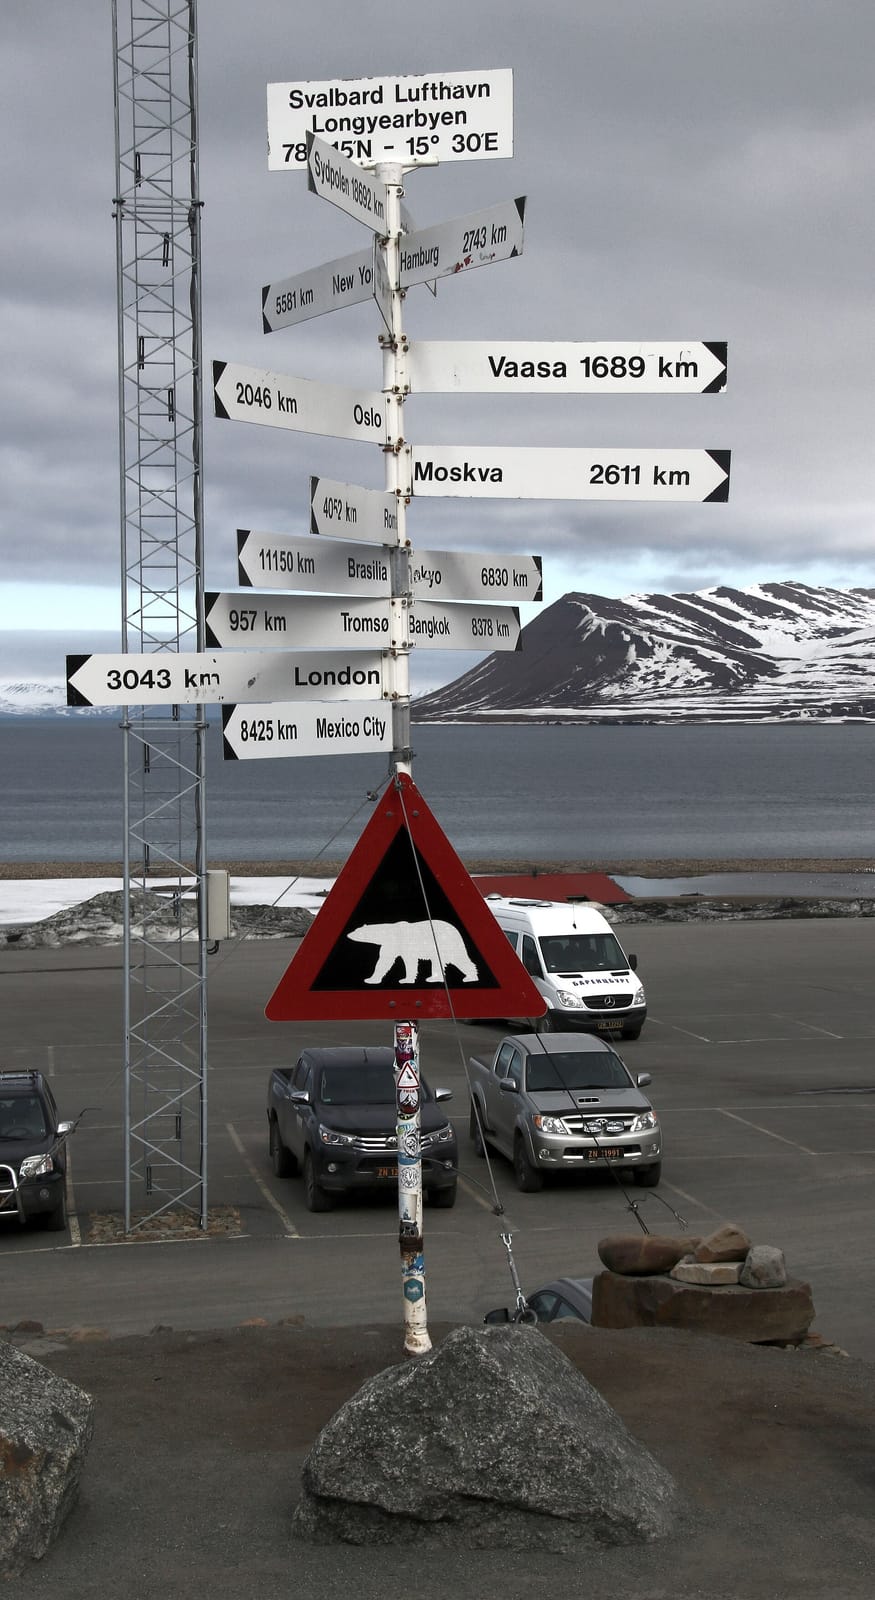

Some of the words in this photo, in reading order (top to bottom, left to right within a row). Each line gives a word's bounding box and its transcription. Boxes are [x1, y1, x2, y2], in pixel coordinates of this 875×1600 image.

[289, 85, 384, 109] Svalbard
[395, 82, 491, 104] Lufthavn
[312, 109, 468, 135] Longyearbyen
[282, 142, 308, 163] 78
[406, 134, 440, 156] 15°
[314, 150, 350, 196] Sydpolen
[351, 177, 372, 211] 18692
[373, 192, 385, 220] km
[400, 246, 440, 273] Hamburg
[462, 226, 488, 254] 2743
[491, 223, 507, 246] km
[275, 290, 297, 315] 5581
[299, 288, 314, 307] km
[332, 274, 355, 296] New
[488, 355, 567, 379] Vaasa
[579, 355, 646, 379] 1689
[657, 356, 699, 379] km
[236, 382, 272, 410] 2046
[277, 390, 298, 415] km
[353, 404, 382, 428] Oslo
[414, 461, 503, 483] Moskva
[589, 464, 641, 486] 2611
[653, 465, 691, 486] km
[345, 501, 357, 523] km
[259, 548, 294, 573] 11150
[297, 551, 315, 574] km
[347, 557, 388, 581] Brasilia
[481, 567, 509, 587] 6830
[512, 569, 528, 588] km
[229, 609, 258, 631] 957
[264, 610, 287, 632] km
[340, 612, 389, 633] Tromsø
[409, 614, 451, 639] Bangkok
[471, 618, 494, 637] 8378
[496, 619, 510, 637] km
[106, 669, 172, 691] 3043
[184, 668, 220, 689] km
[294, 666, 381, 687] London
[240, 719, 274, 742] 8425
[277, 718, 298, 741] km
[316, 717, 360, 739] Mexico
[363, 716, 387, 741] City
